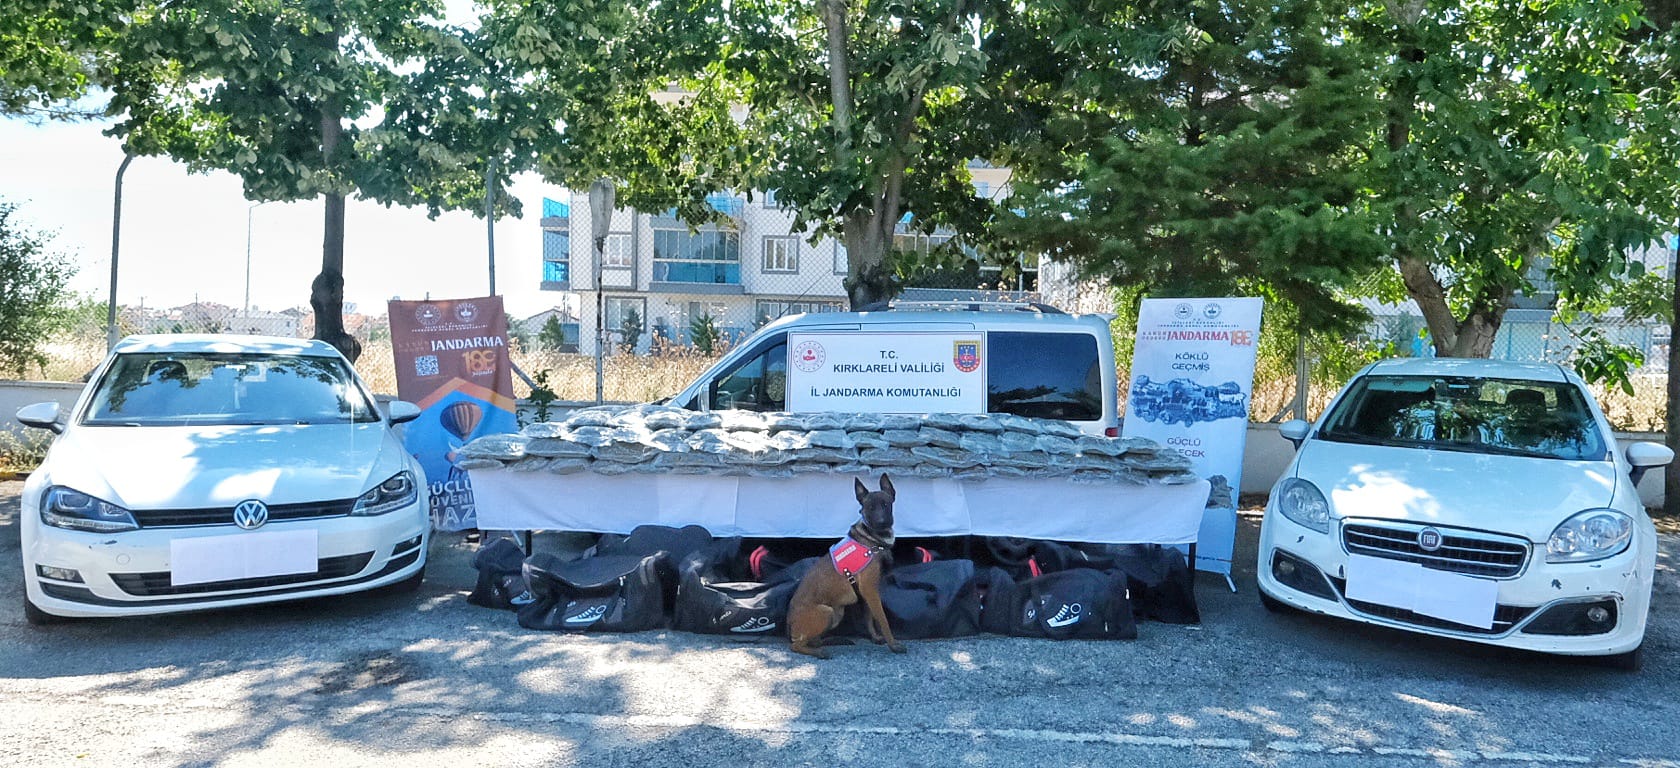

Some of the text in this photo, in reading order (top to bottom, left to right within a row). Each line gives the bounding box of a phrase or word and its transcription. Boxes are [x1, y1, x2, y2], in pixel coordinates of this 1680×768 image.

[1167, 331, 1230, 341] JANDARMA
[431, 336, 504, 352] JANDARMA
[880, 350, 899, 359] T.C.
[1175, 352, 1209, 361] KÖKLÜ
[833, 363, 945, 373] KIRKLARELİ VALİLİĞİ
[1171, 362, 1211, 372] GEÇMİŞ
[810, 386, 961, 397] İL JANDARMA KOMUTANLIĞI
[1167, 436, 1201, 447] GÜÇLÜ
[1178, 448, 1206, 458] ECEK
[1423, 534, 1436, 545] FIAT
